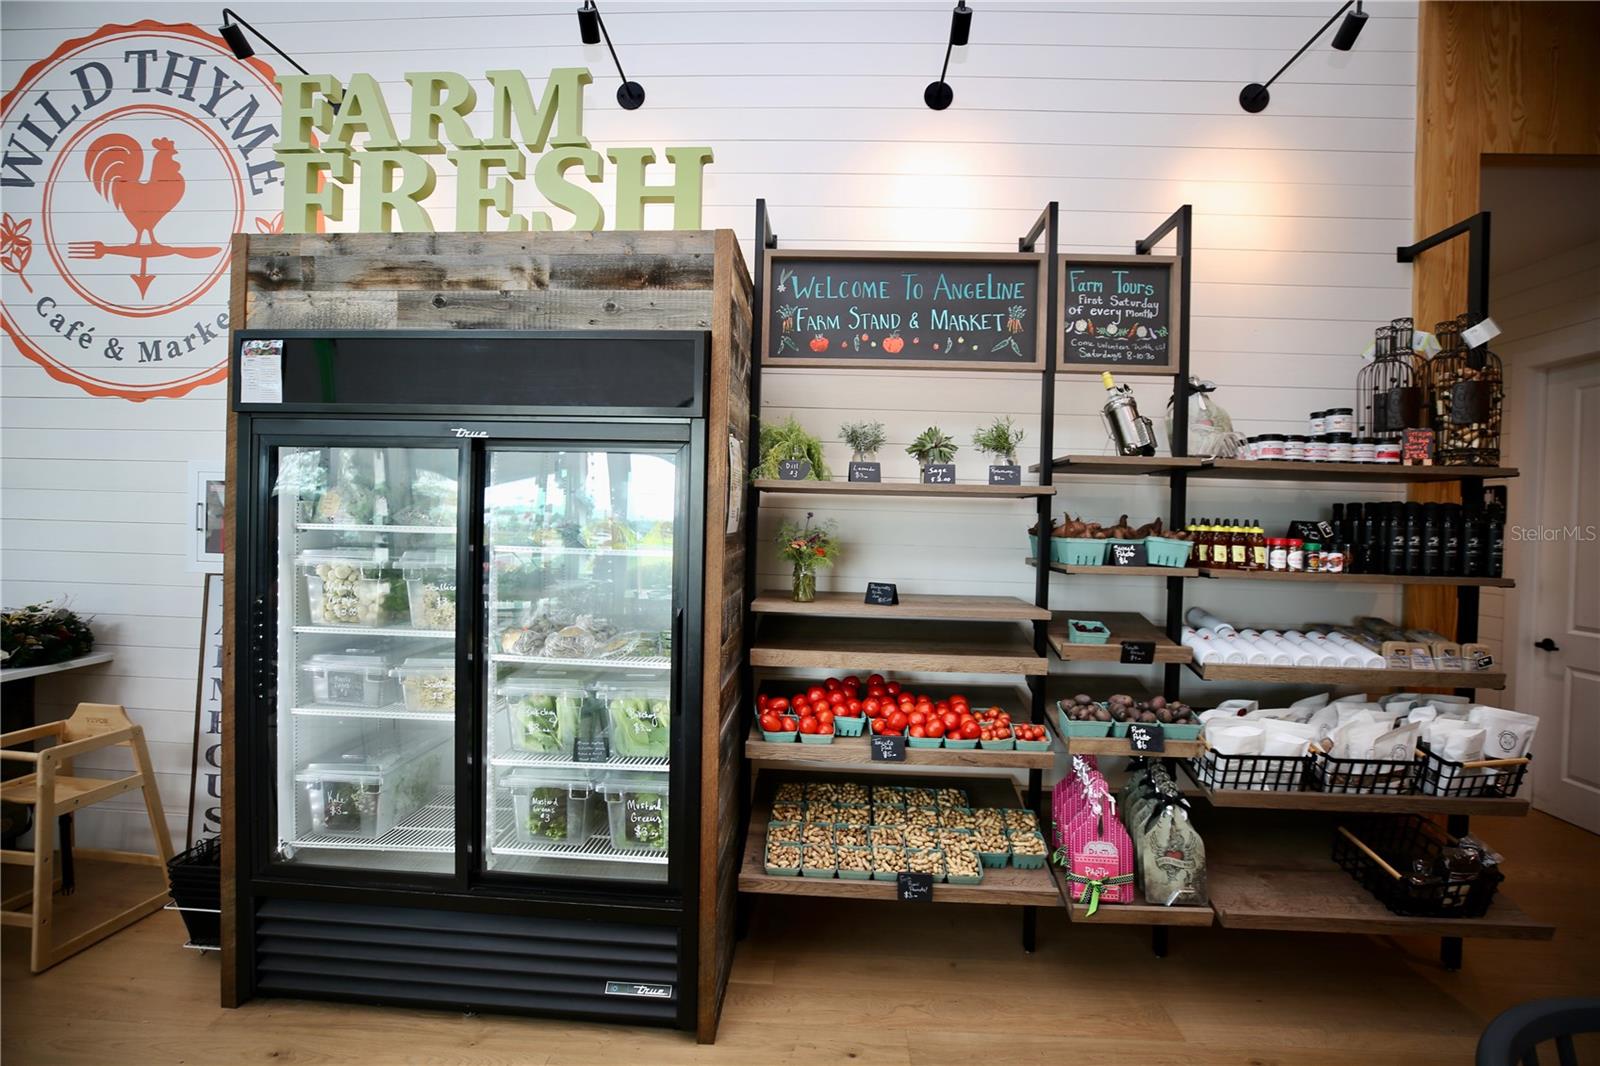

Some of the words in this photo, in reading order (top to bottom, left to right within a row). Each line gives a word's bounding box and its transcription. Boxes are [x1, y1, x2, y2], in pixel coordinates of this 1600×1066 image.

[273, 67, 593, 154] FARM
[0, 61, 114, 188] WILD
[124, 49, 285, 196] THYME
[275, 146, 714, 232] FRESH
[909, 311, 920, 329] &
[1068, 306, 1084, 315] of
[1090, 307, 1122, 324] every
[36, 296, 96, 349] Café
[103, 337, 125, 361] &
[138, 295, 231, 363] Marke
[1078, 346, 1122, 361] Saturdays
[928, 467, 947, 477] Sage
[532, 797, 560, 806] Mustard
[626, 798, 663, 811] Mustard
[630, 812, 662, 823] Greens
